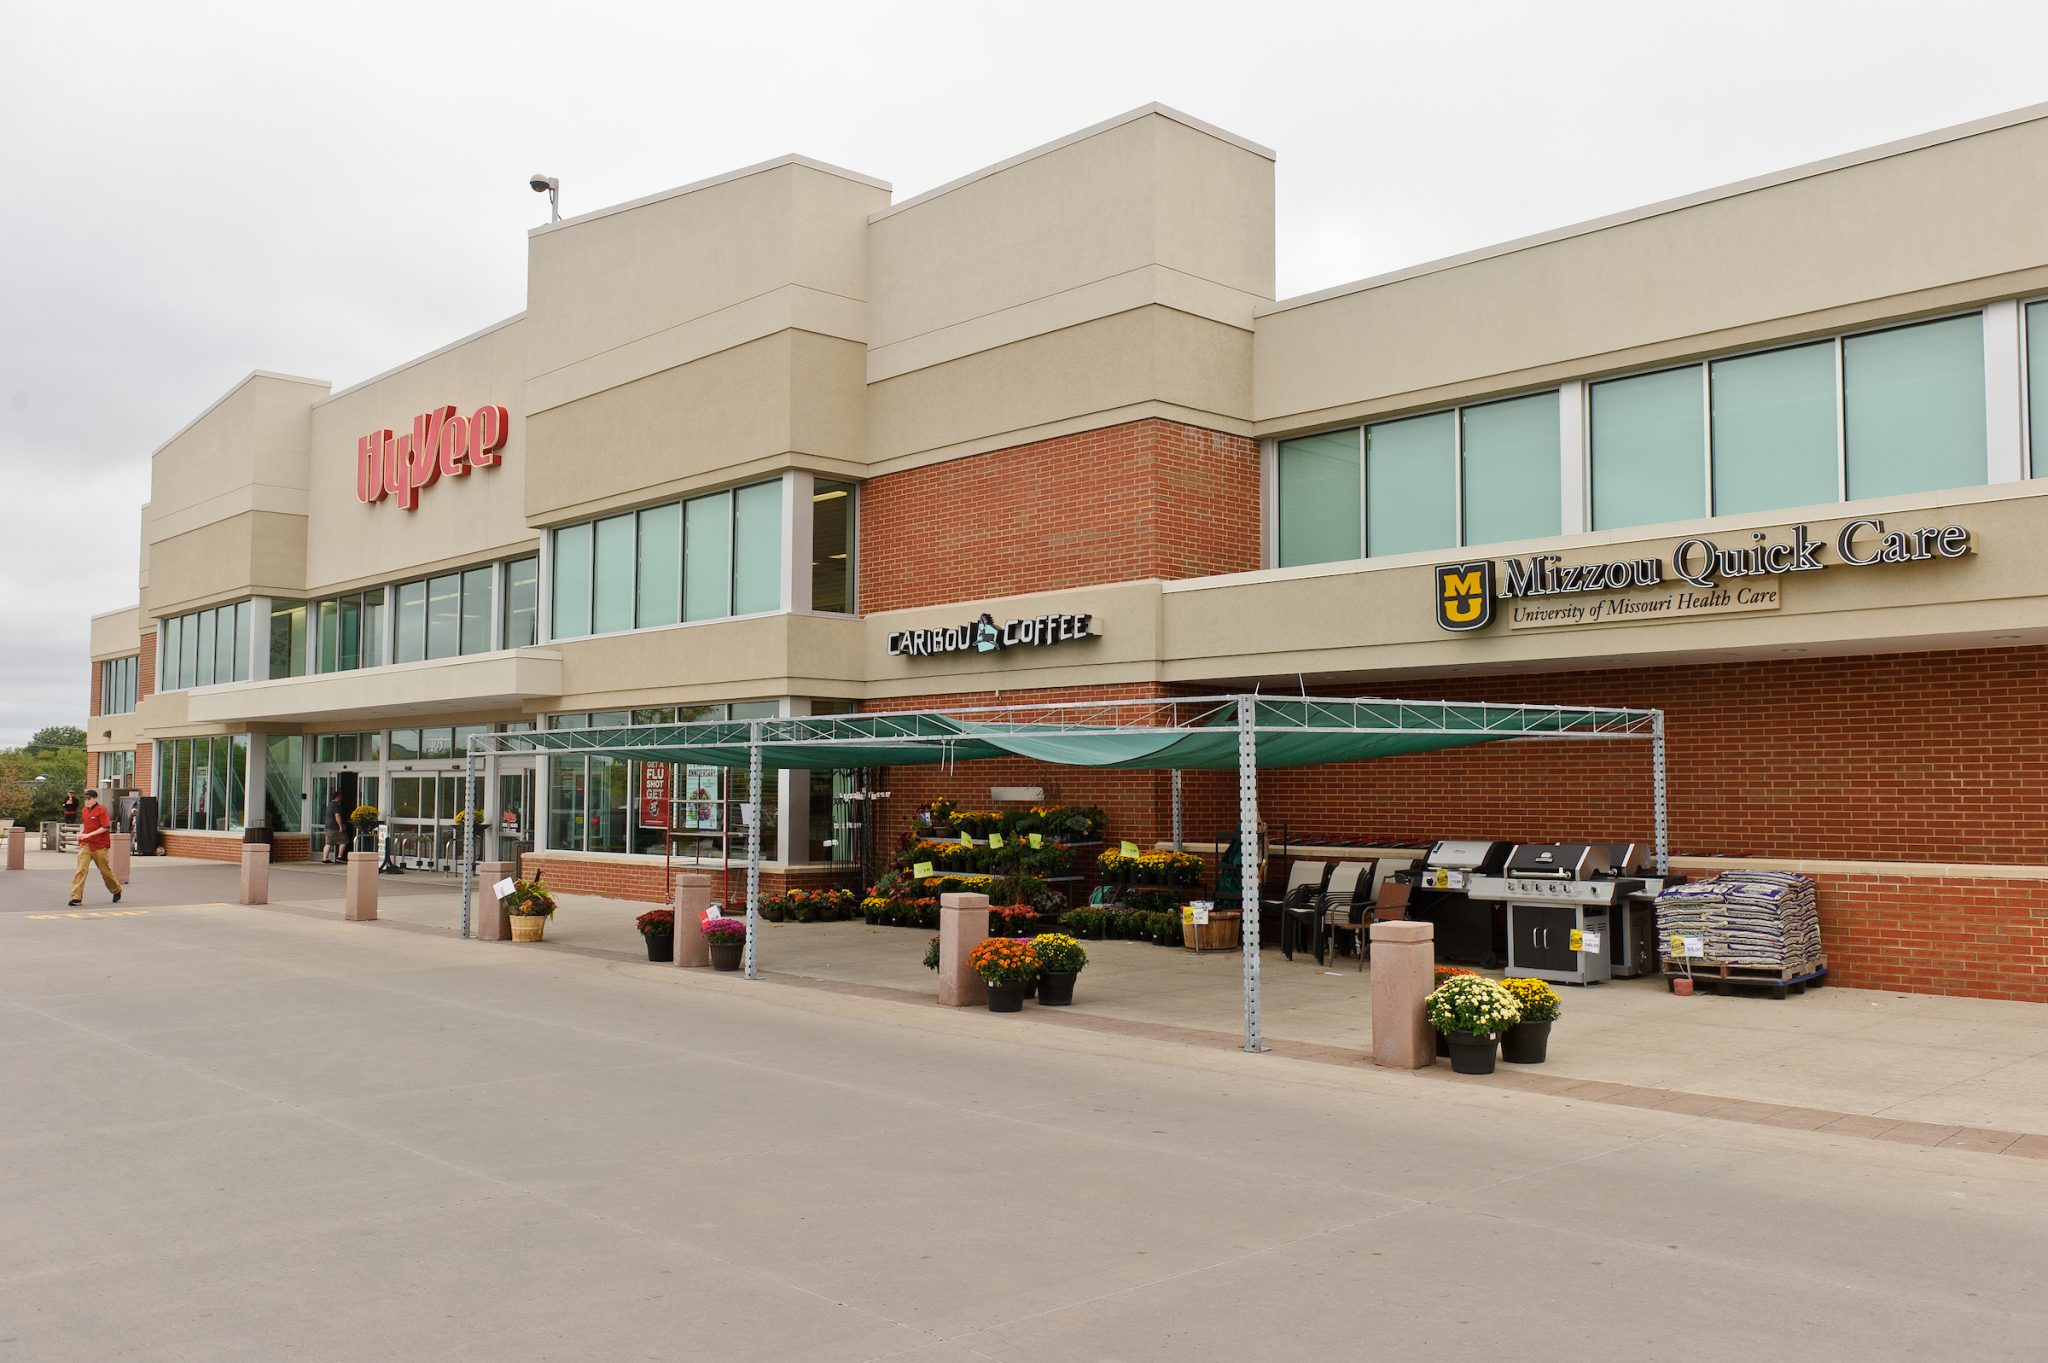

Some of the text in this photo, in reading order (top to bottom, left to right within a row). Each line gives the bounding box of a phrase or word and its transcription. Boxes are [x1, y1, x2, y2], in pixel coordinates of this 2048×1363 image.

[1498, 519, 1971, 598] Mizzou Quick Care
[1513, 587, 1777, 623] University of Missouri Health Care
[888, 614, 1090, 656] CARIBOU COFFEE
[646, 768, 664, 780] FLU
[646, 780, 664, 788] SHOT
[646, 789, 664, 800] GET
